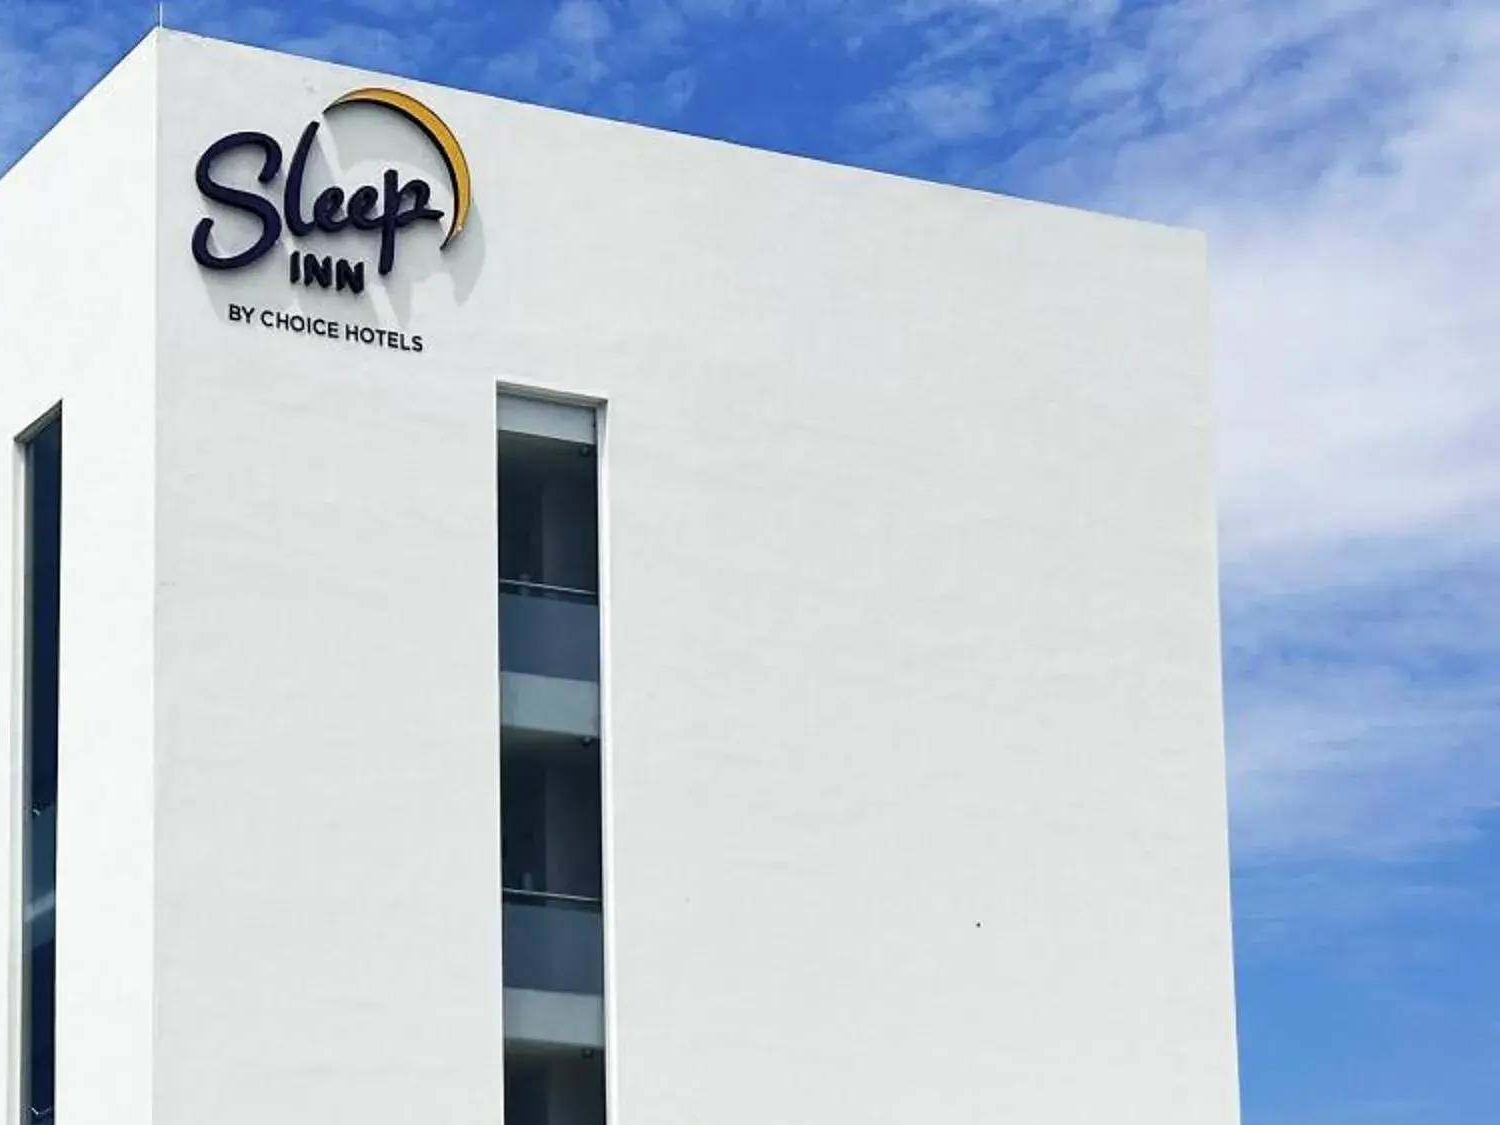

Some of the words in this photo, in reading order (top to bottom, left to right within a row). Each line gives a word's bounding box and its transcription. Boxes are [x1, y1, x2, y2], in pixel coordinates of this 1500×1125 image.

[191, 120, 445, 276] Sleep
[289, 250, 365, 294] INN
[228, 303, 255, 324] BY
[259, 310, 340, 339] CHOICE
[345, 323, 424, 353] HOTELS
